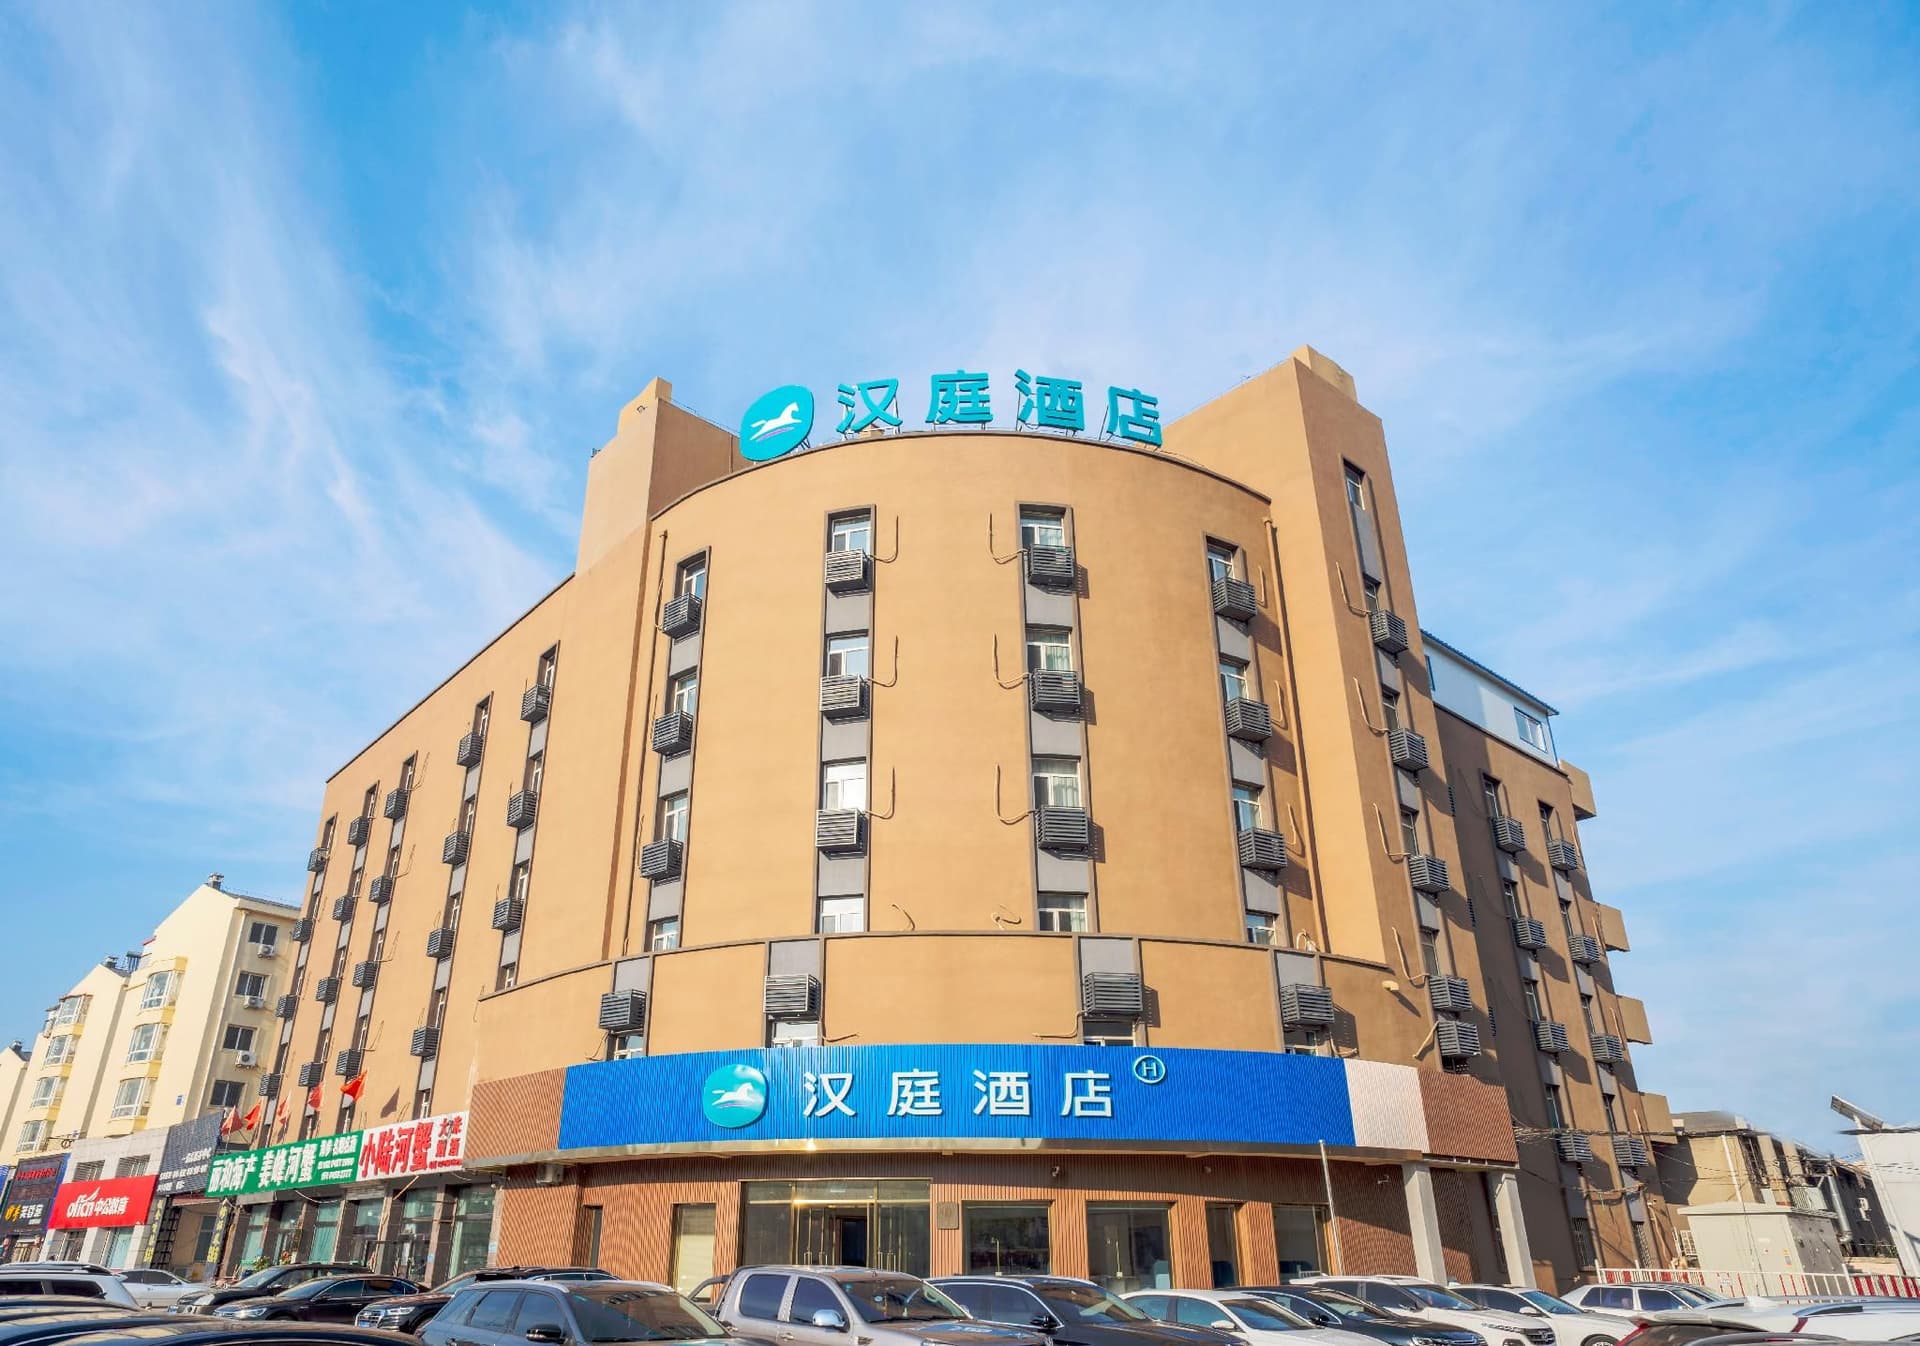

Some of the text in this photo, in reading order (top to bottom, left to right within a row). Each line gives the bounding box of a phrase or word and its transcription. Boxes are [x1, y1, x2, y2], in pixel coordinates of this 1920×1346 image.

[837, 369, 1163, 446] 汉庭酒店
[803, 1067, 1112, 1117] 汉庭酒店
